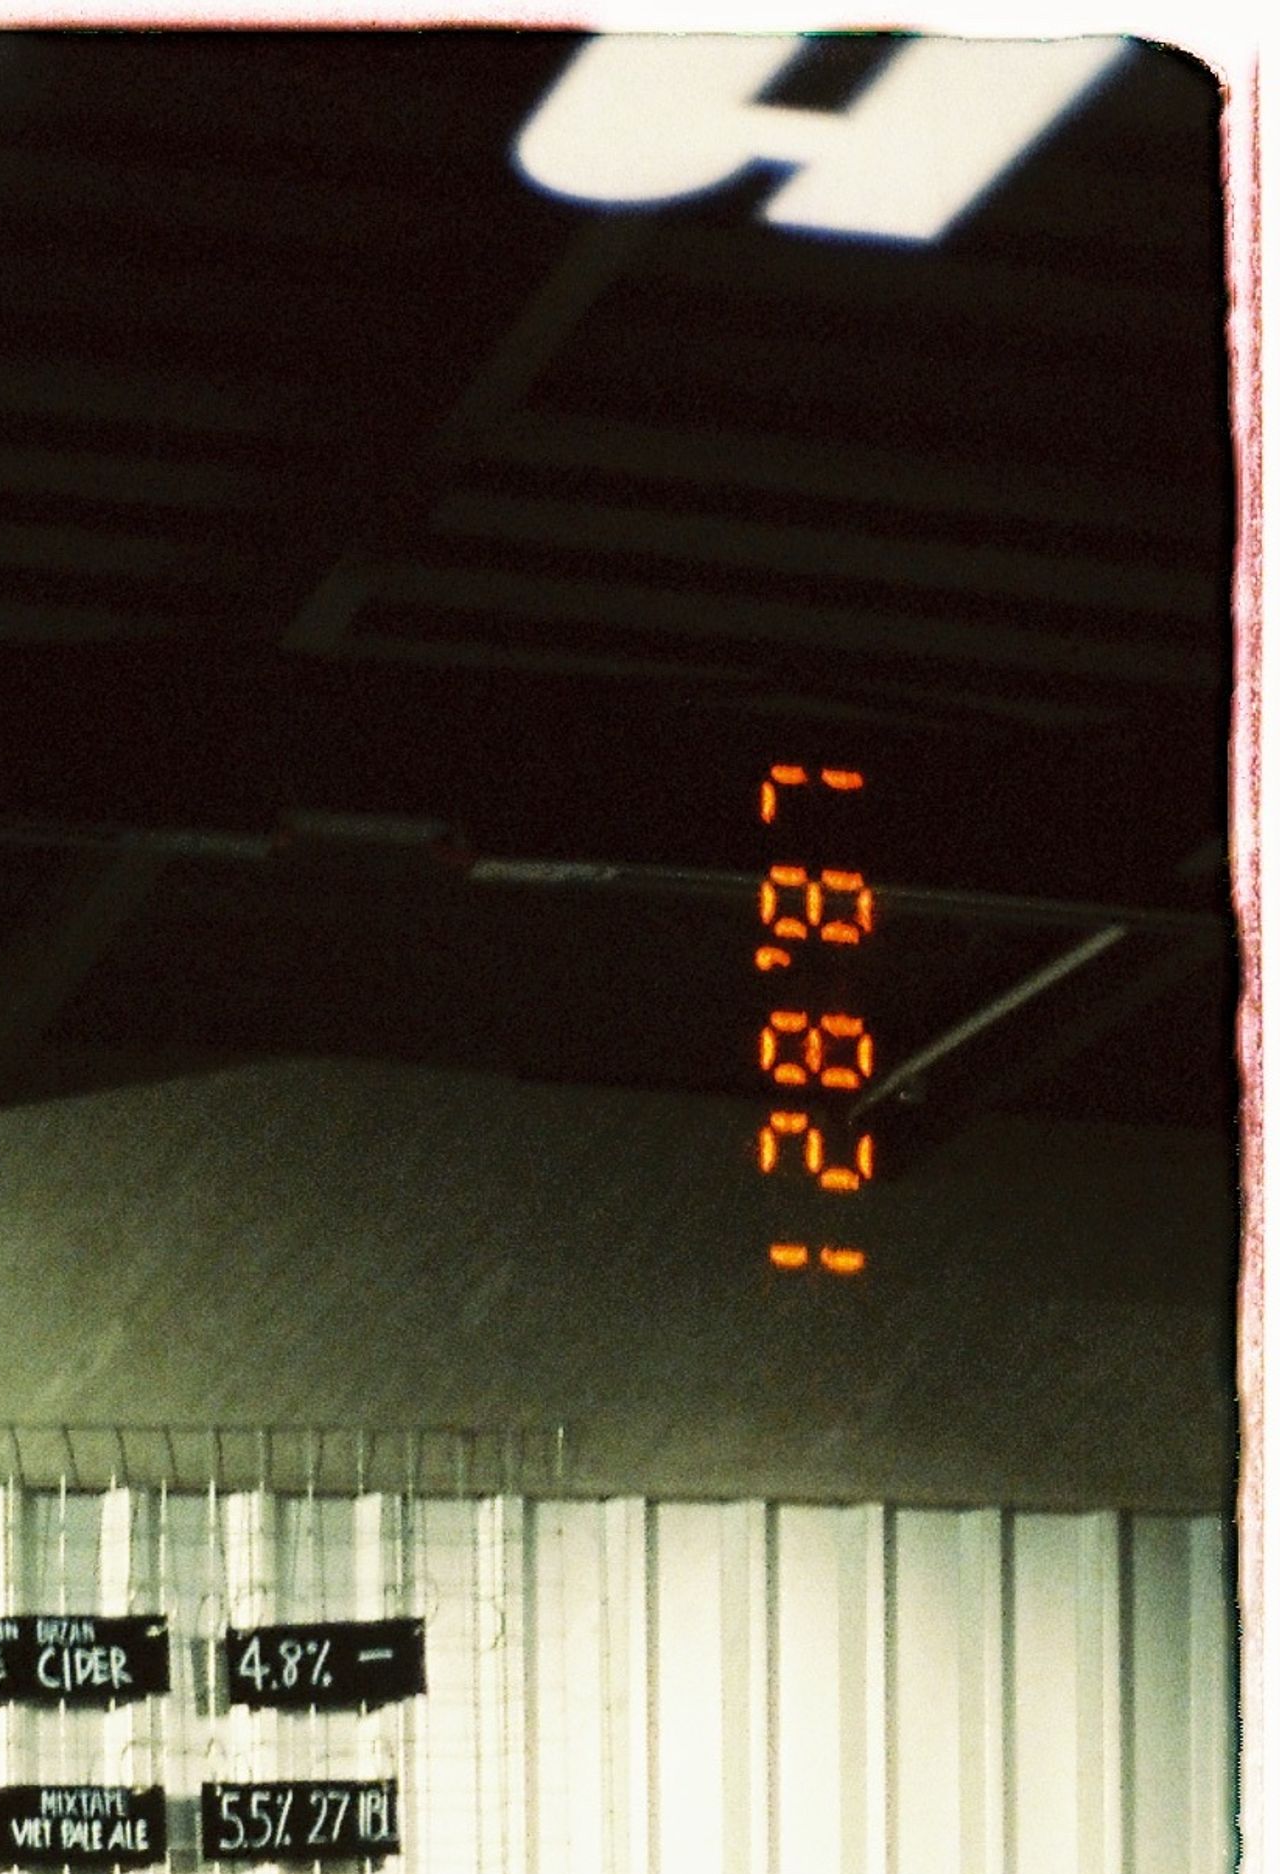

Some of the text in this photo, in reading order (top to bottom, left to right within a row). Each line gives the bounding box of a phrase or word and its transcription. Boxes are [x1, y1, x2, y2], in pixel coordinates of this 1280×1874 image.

[38, 1644, 134, 1692] CIDER
[239, 1635, 334, 1692] 4.8%
[60, 1818, 103, 1852] PALE
[108, 1818, 149, 1852] ALE
[219, 1789, 295, 1851] 5.5%
[307, 1789, 350, 1845] 27
